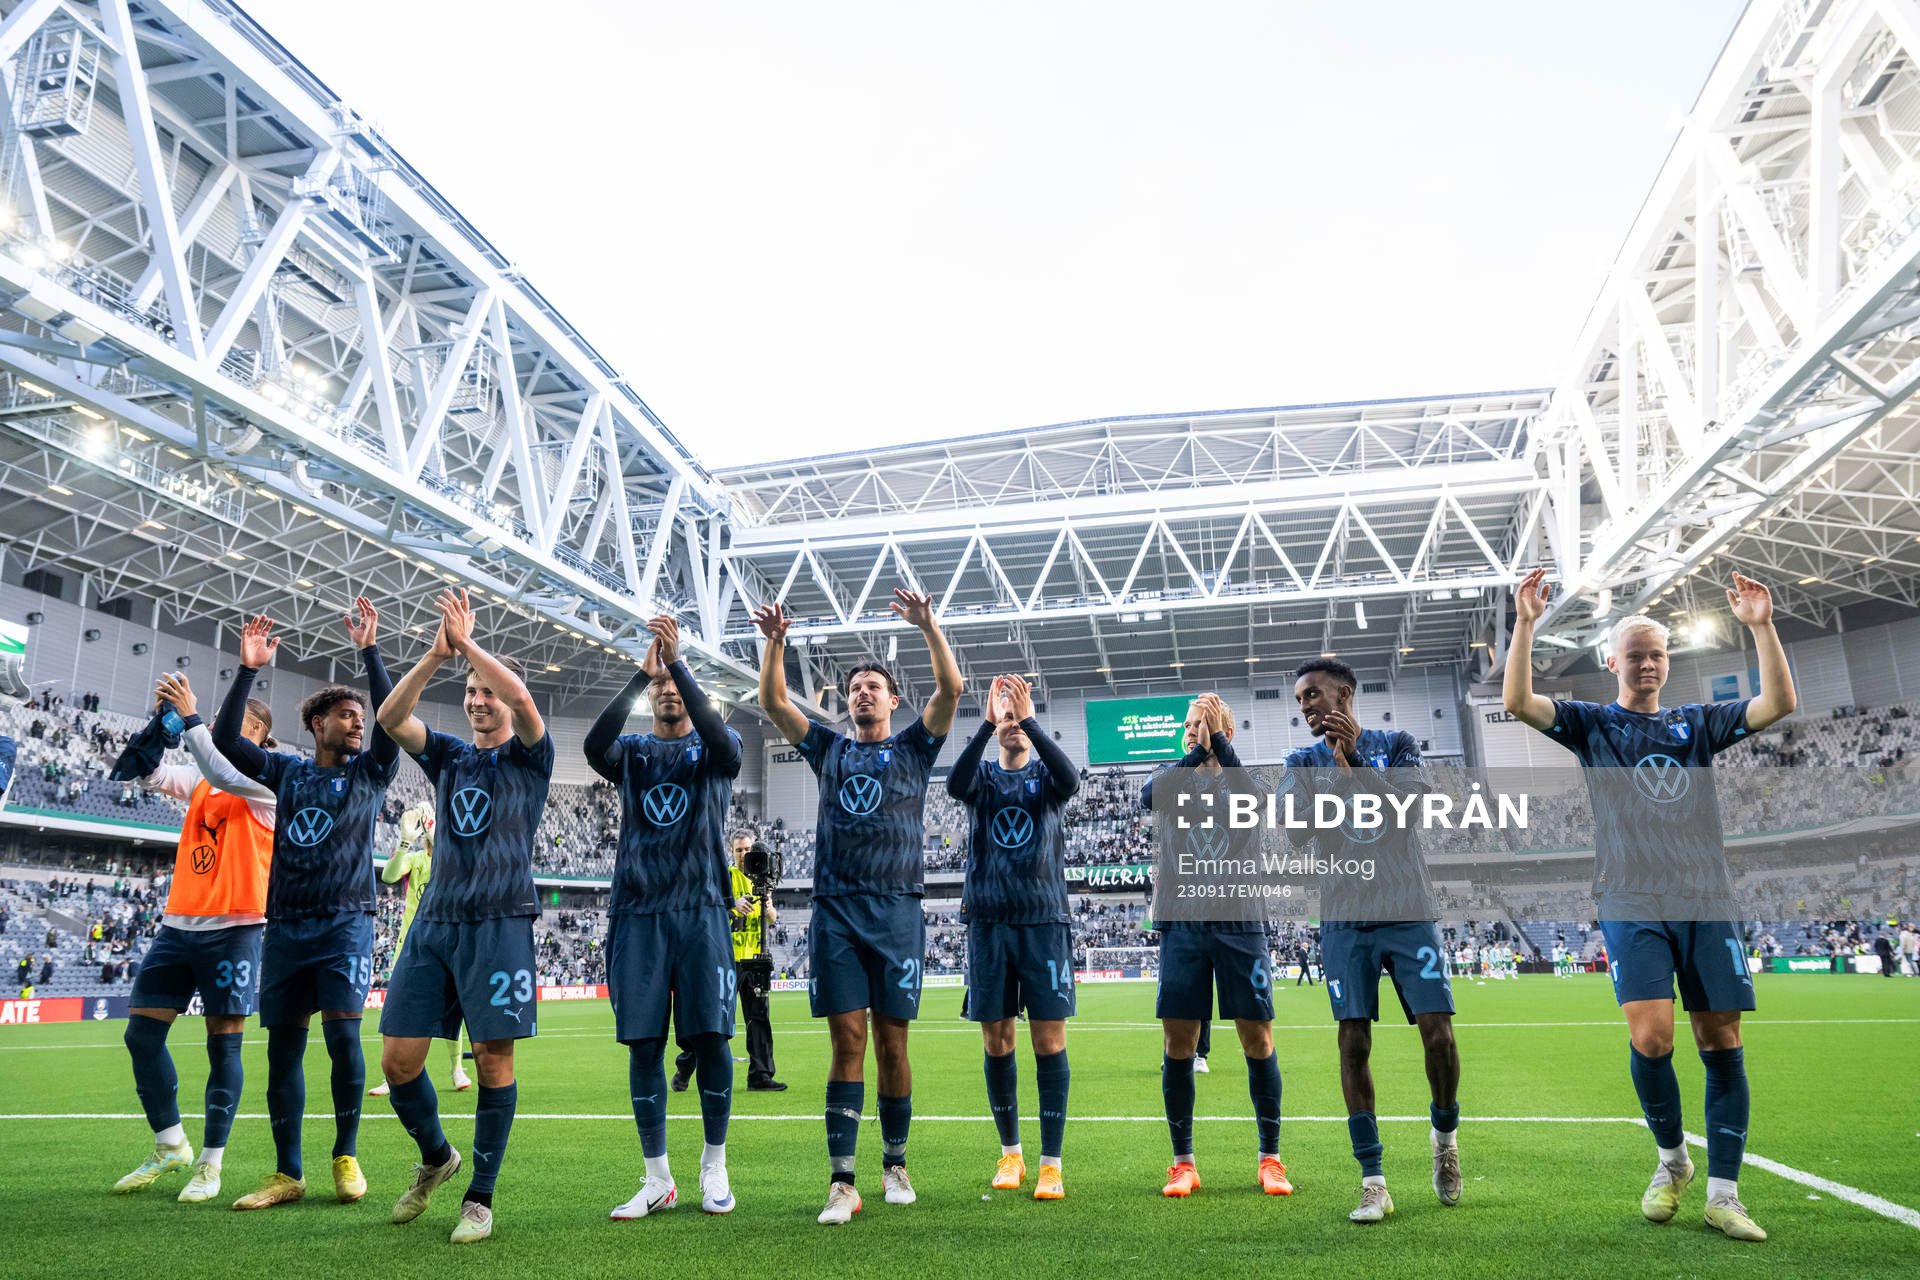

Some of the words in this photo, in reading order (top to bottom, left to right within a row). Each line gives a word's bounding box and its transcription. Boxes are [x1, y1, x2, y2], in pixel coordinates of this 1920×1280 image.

[1485, 711, 1521, 723] TELE
[216, 960, 250, 988] 33
[348, 956, 370, 986] 15
[717, 966, 737, 1000] 19
[1047, 959, 1072, 990] 14
[489, 968, 533, 1007] 23
[1, 1001, 41, 1023] ATE
